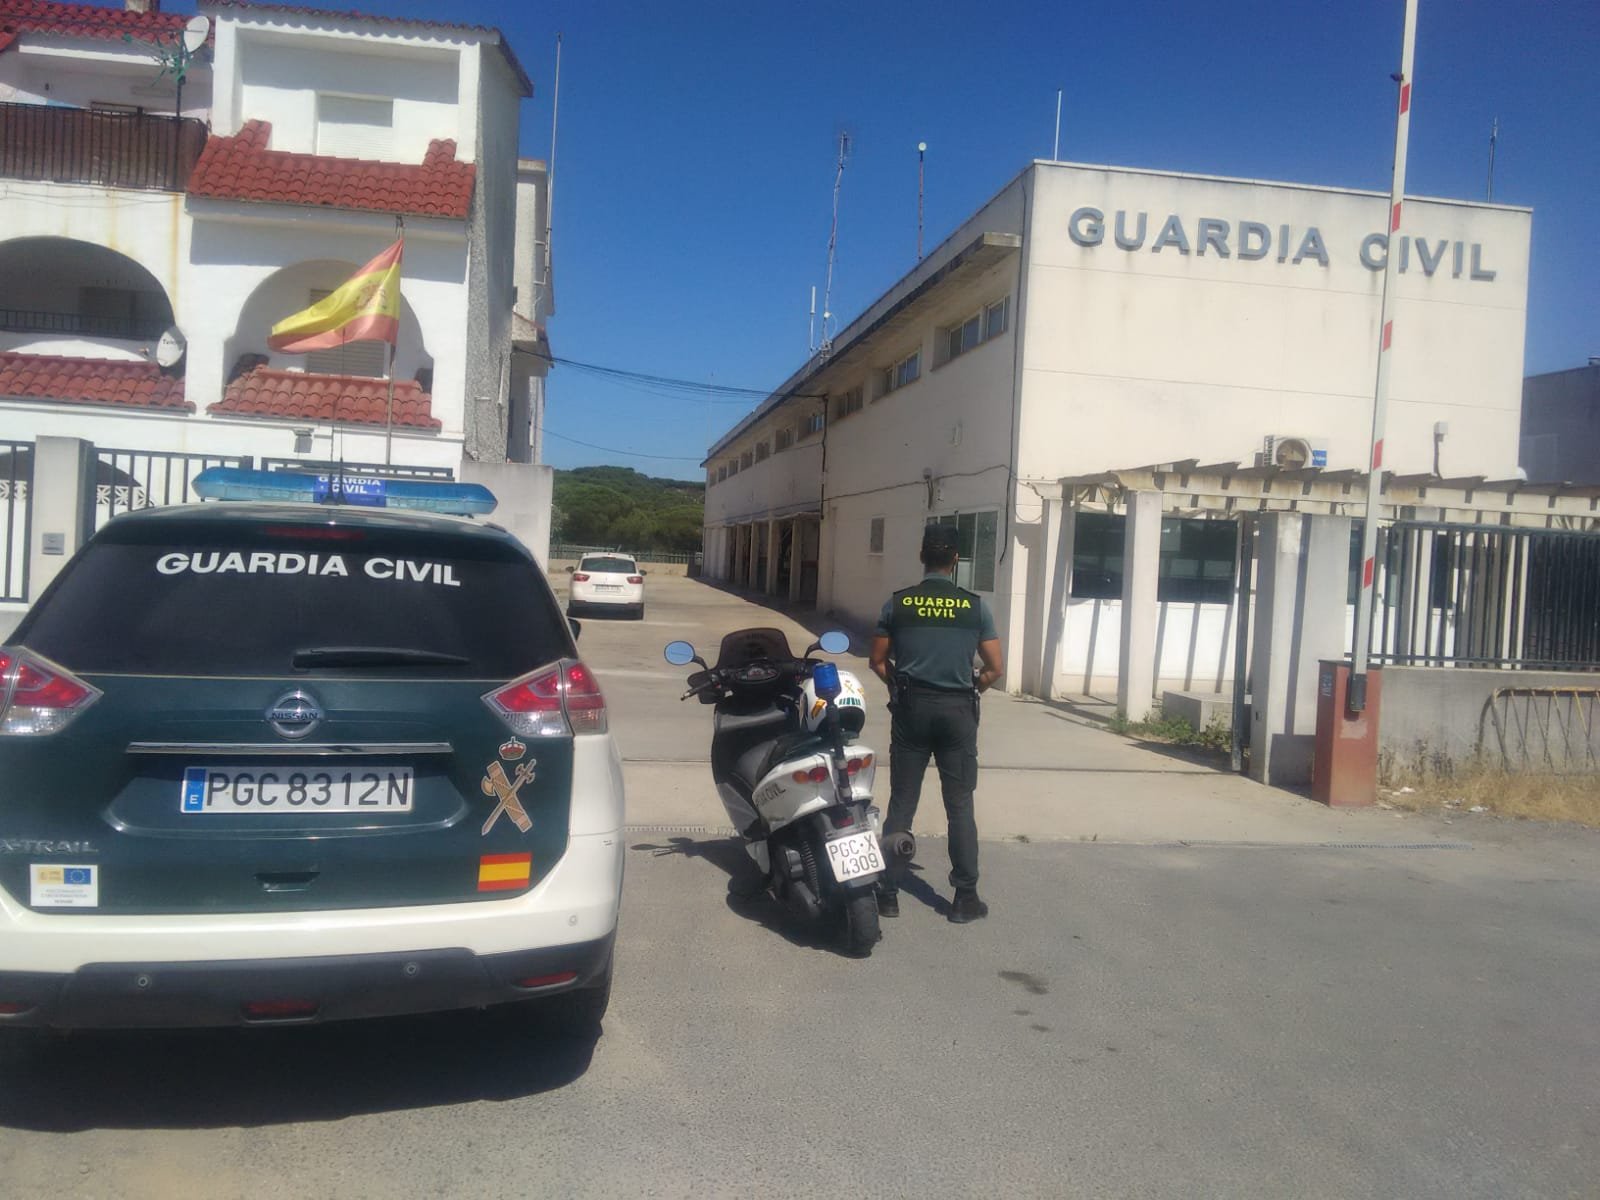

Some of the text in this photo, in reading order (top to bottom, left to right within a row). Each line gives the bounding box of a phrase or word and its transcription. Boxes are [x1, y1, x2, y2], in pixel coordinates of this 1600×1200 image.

[1068, 207, 1497, 282] GUARDIA CIVIL
[156, 552, 461, 587] GUARDIA CIVIL
[902, 596, 971, 609] GUARDIA
[918, 607, 956, 618] CIVIL
[271, 711, 319, 720] NISSAN
[841, 852, 879, 876] 4309
